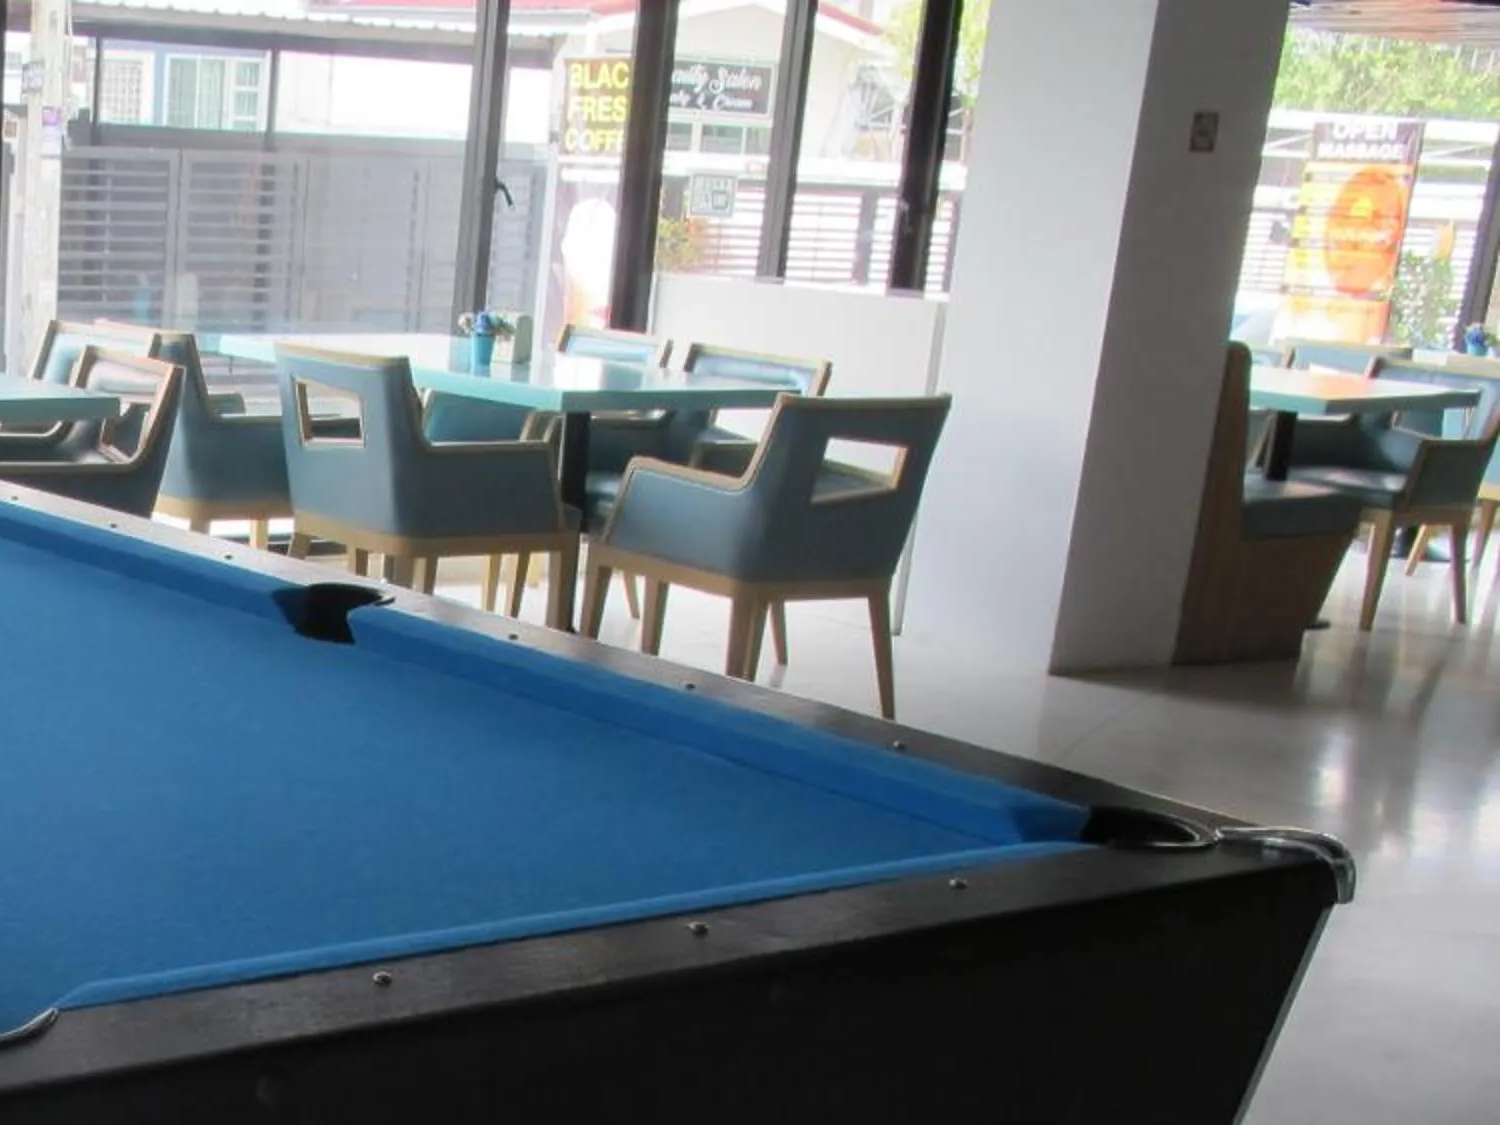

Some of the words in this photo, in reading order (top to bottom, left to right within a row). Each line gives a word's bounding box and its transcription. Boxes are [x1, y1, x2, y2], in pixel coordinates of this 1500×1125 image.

[570, 61, 630, 89] BLAC
[708, 67, 761, 95] Salon
[567, 95, 627, 122] FRES
[564, 127, 624, 152] COFF
[1333, 119, 1398, 140] OPEN
[1318, 142, 1404, 159] MASSAGE
